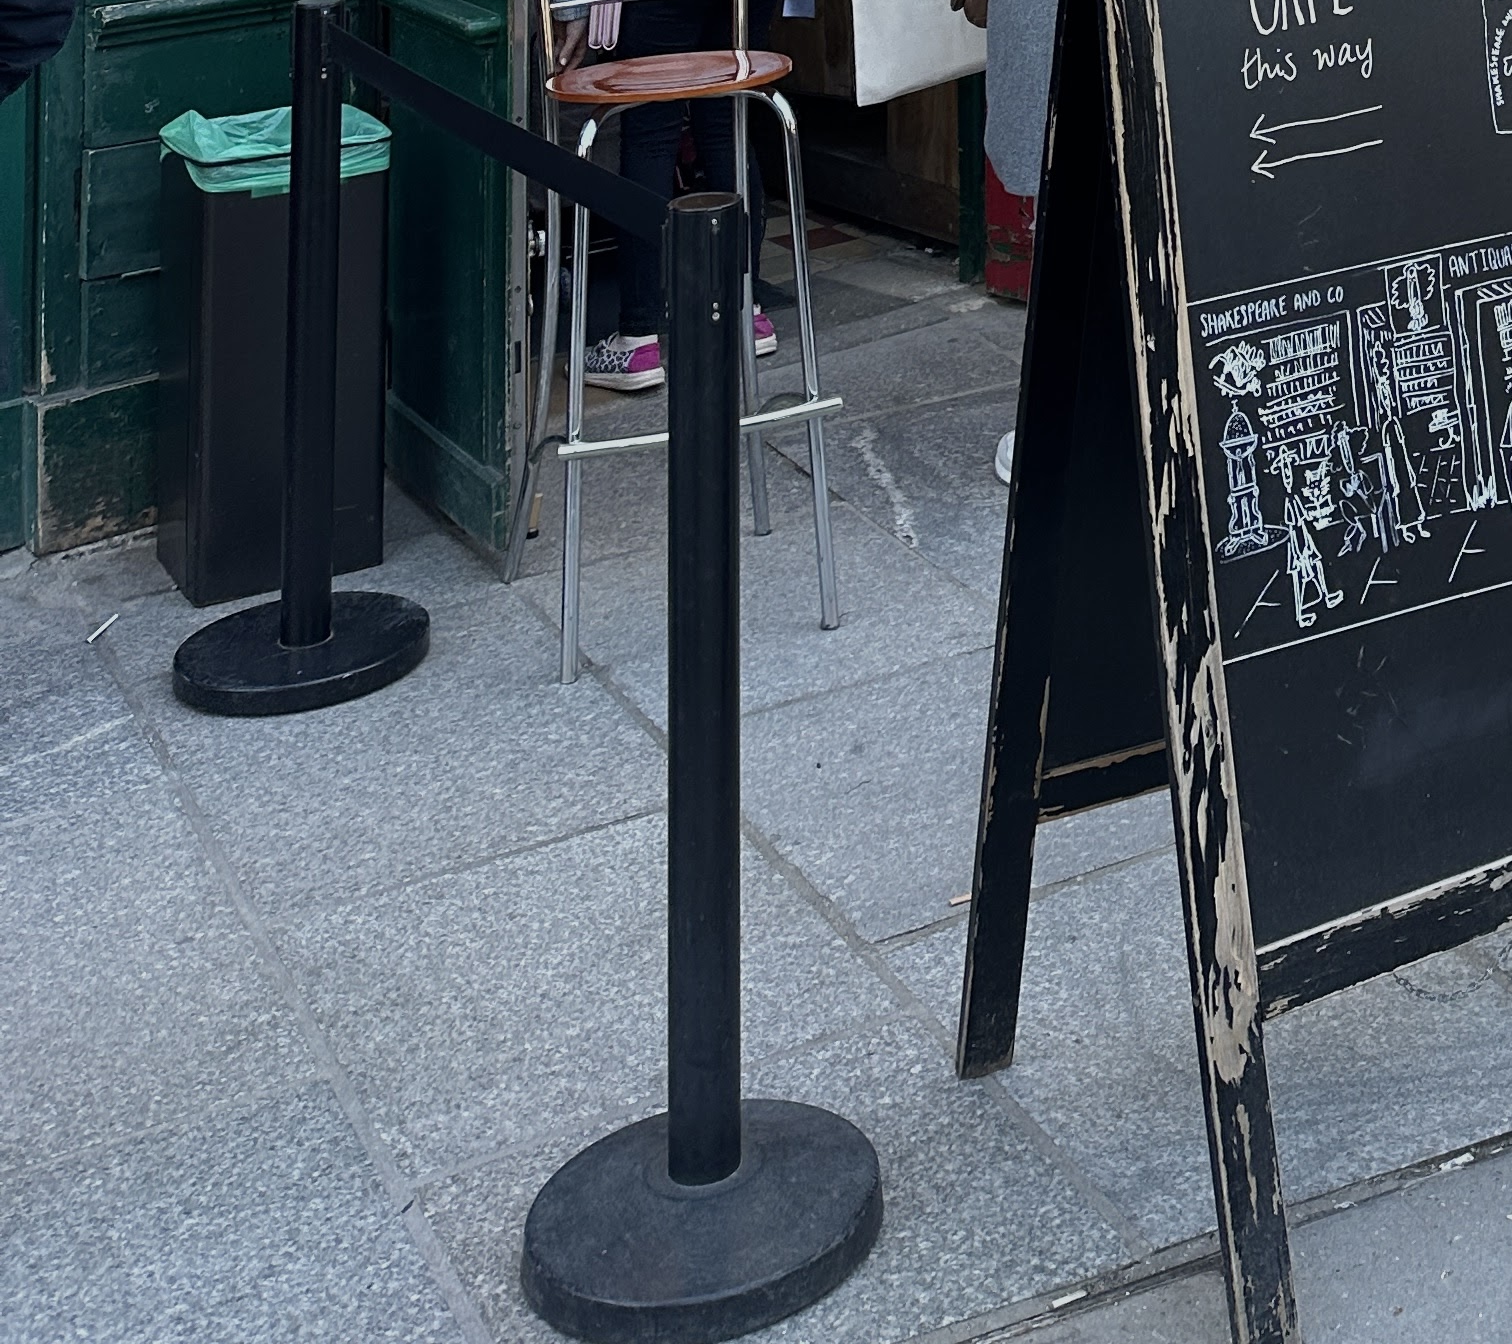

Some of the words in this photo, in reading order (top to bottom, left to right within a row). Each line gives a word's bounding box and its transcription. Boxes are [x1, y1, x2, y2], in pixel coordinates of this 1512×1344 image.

[1240, 46, 1298, 91] this
[1316, 37, 1375, 80] way
[1200, 295, 1287, 338] SHAKESPEARE
[1294, 290, 1323, 309] AND
[1327, 285, 1345, 303] CO
